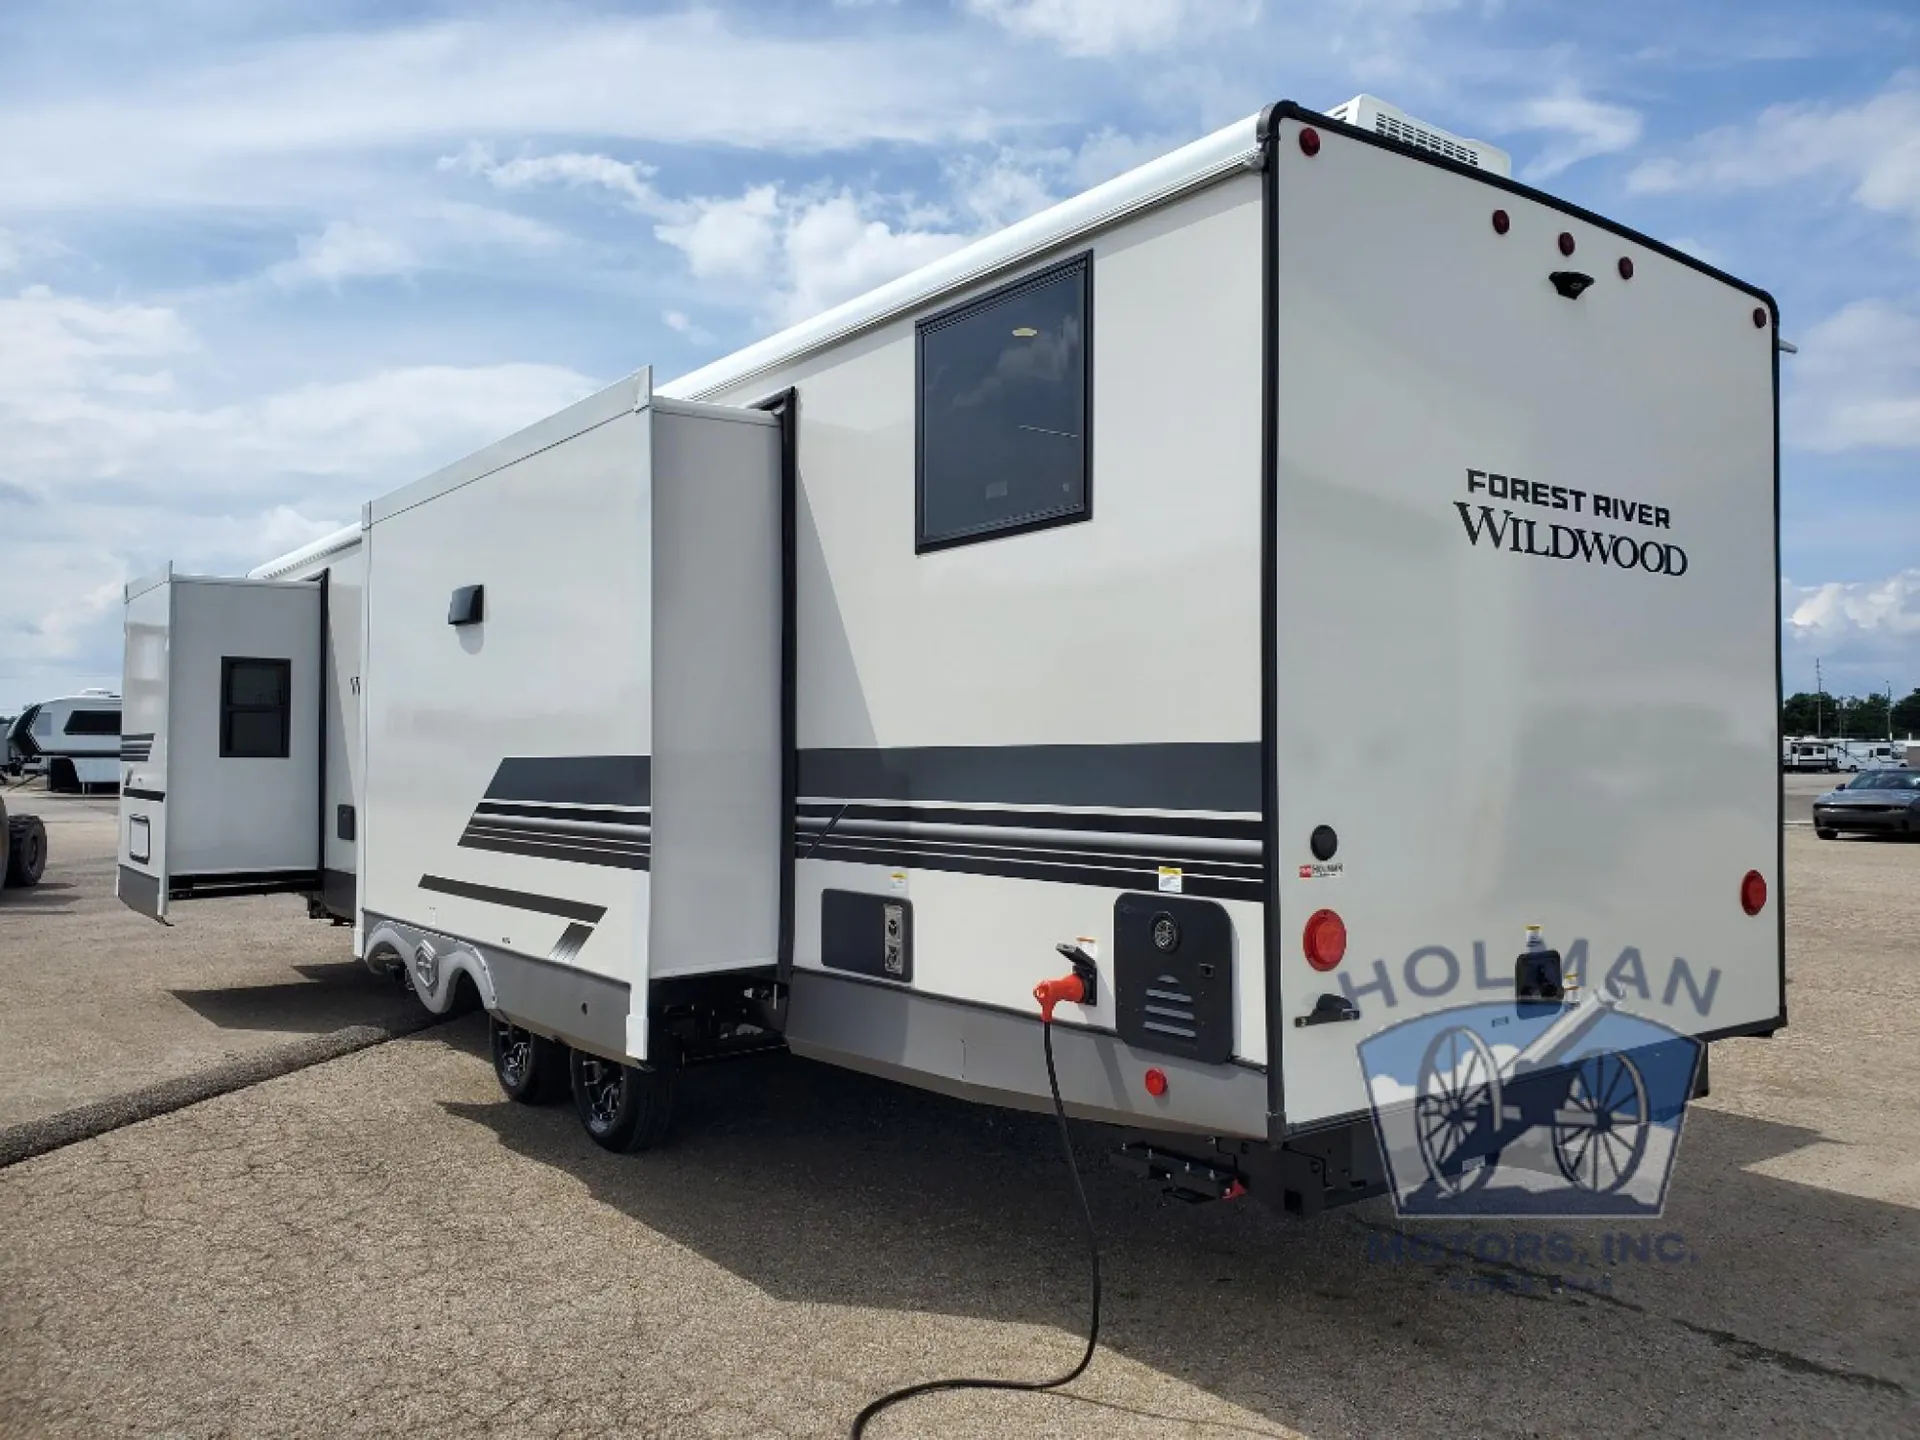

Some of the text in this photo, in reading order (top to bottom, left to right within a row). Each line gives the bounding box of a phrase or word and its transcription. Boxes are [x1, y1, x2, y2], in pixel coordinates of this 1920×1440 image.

[1466, 468, 1671, 529] FOREST RIVER
[1453, 501, 1688, 576] WILDWOOD
